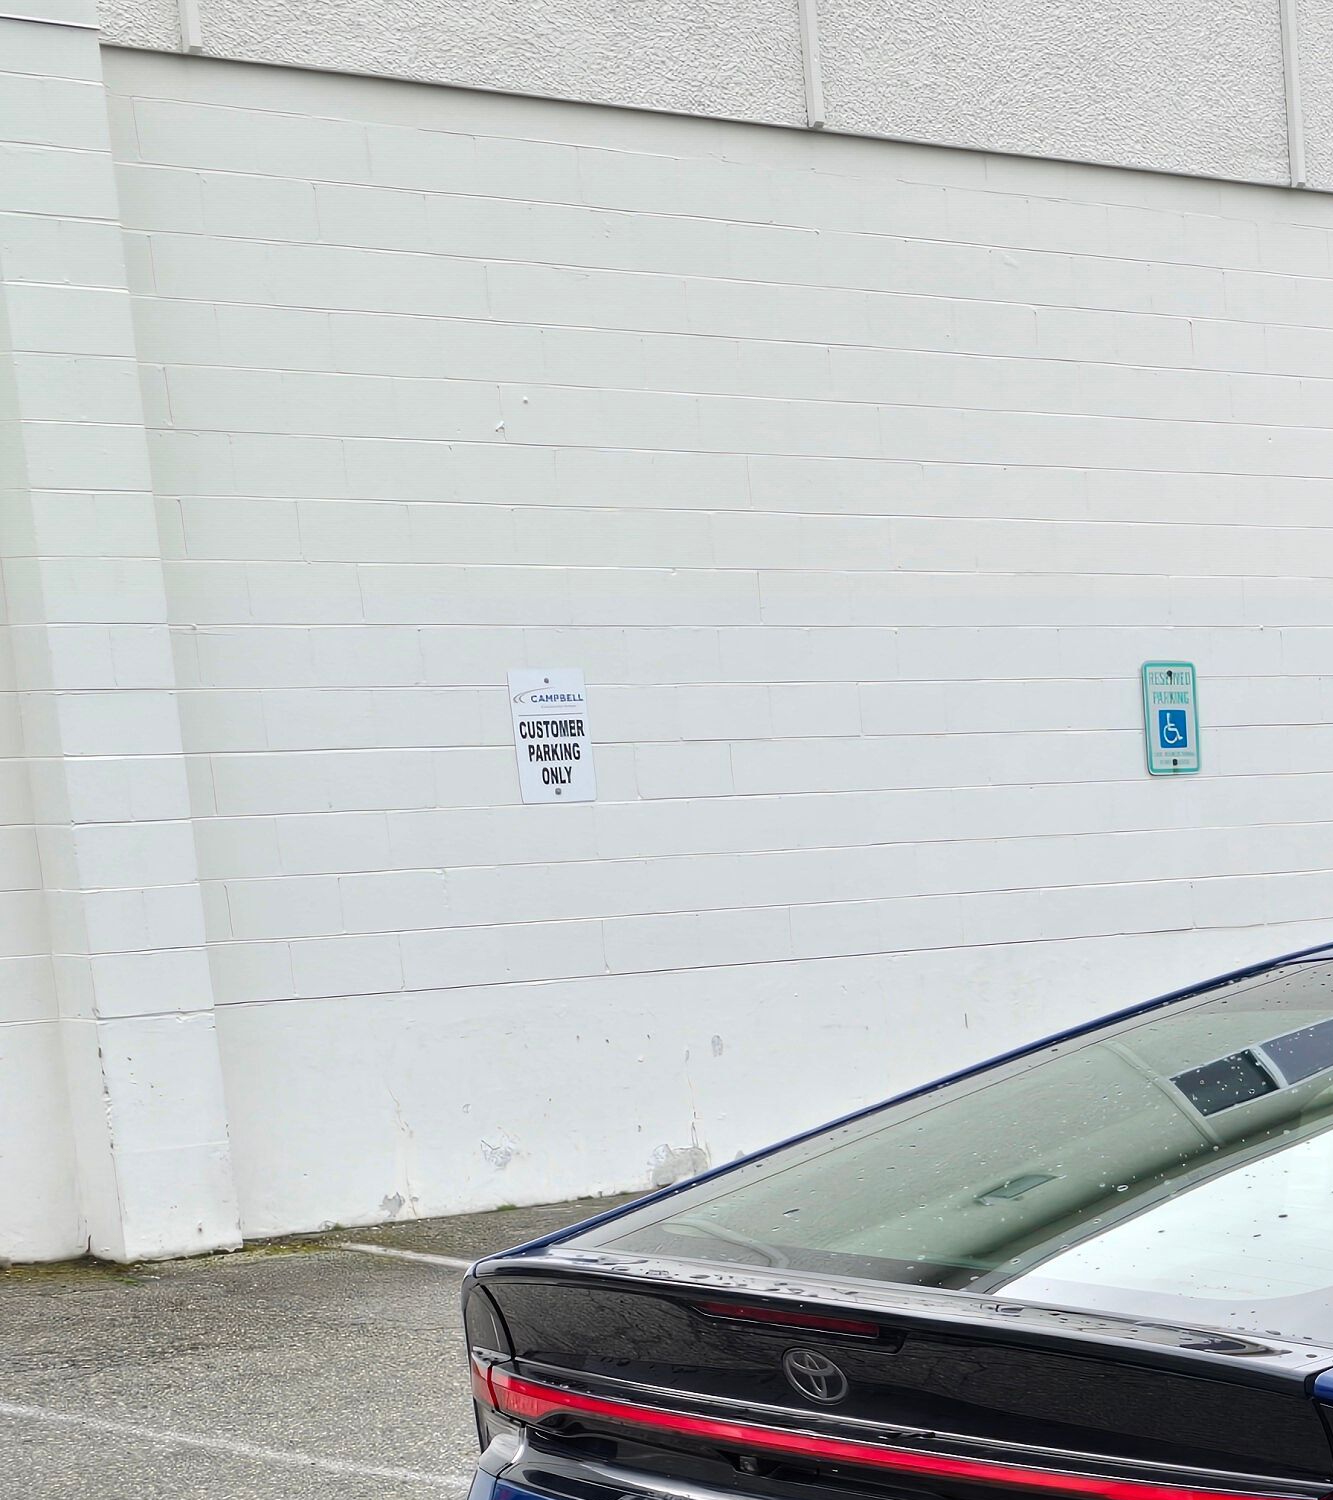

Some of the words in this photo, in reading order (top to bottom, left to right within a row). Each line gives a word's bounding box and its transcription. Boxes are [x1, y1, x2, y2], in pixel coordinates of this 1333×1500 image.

[530, 693, 584, 703] CAMPBELL
[1153, 691, 1190, 705] PARKING
[519, 719, 585, 740] CUSTOMER
[528, 742, 581, 762] PARKING
[541, 765, 573, 785] ONLY
